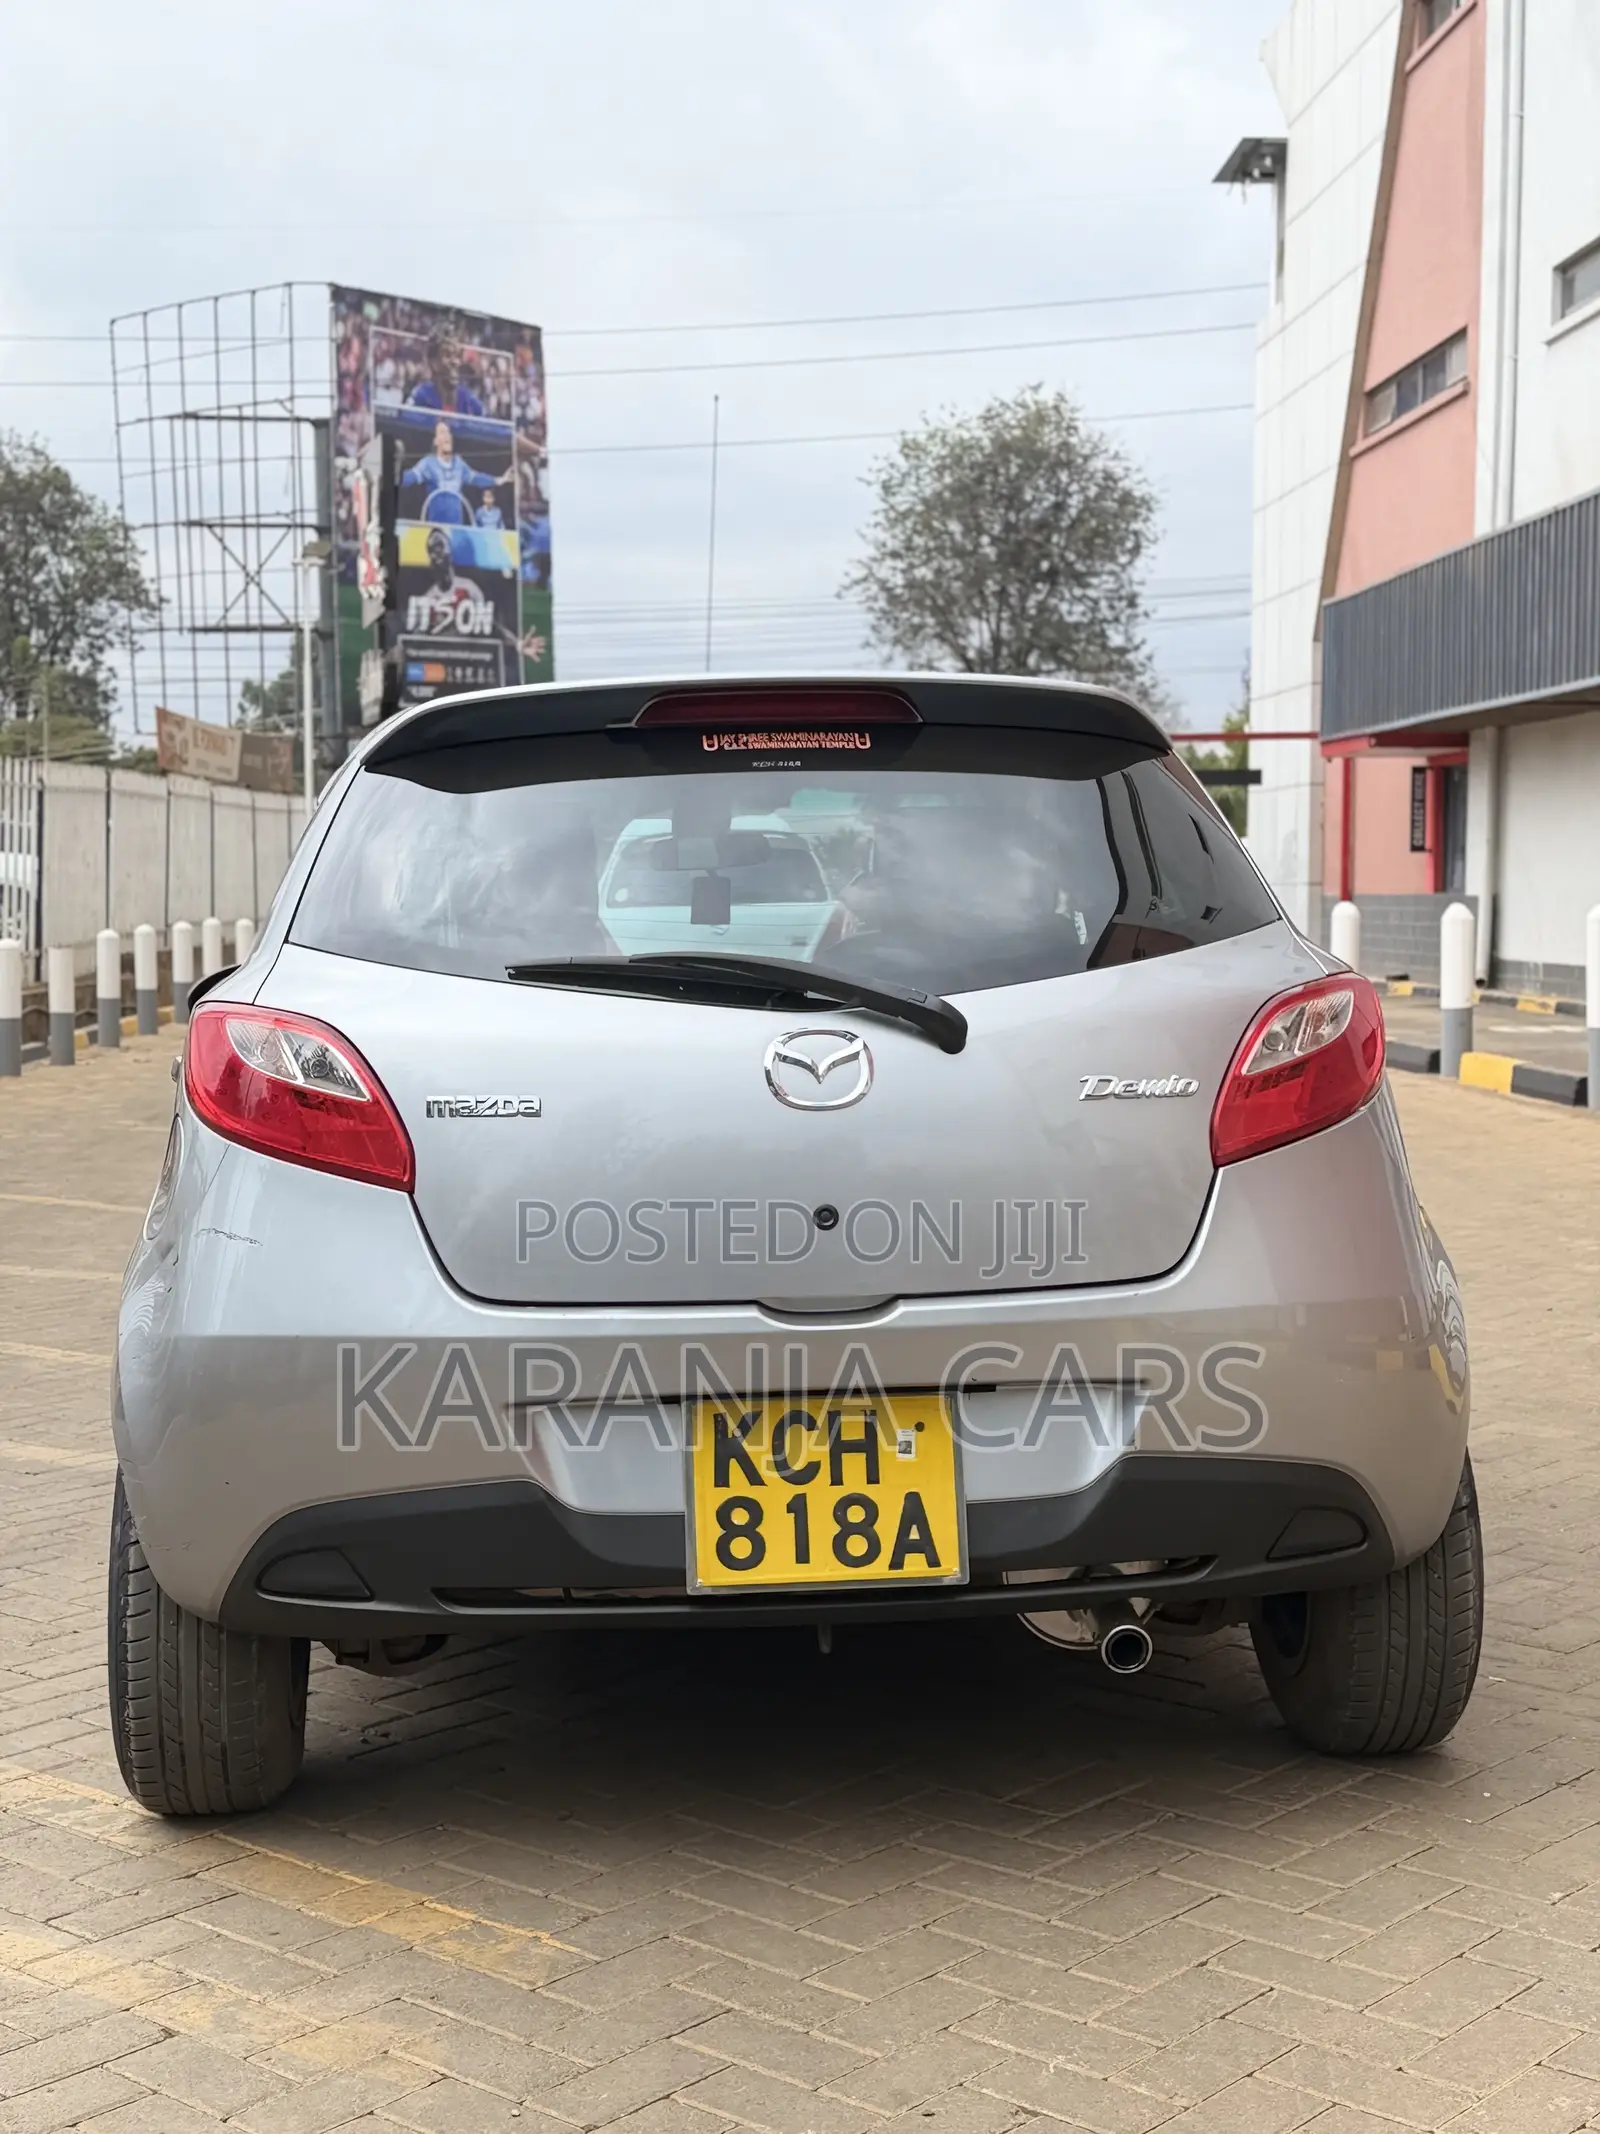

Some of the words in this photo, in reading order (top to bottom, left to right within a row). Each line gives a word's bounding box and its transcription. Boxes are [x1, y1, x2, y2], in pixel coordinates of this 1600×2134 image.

[770, 732, 854, 742] SWAMINARAYAN
[1079, 1074, 1200, 1101] Demio
[713, 1410, 880, 1488] KCH
[715, 1491, 942, 1571] 818A
